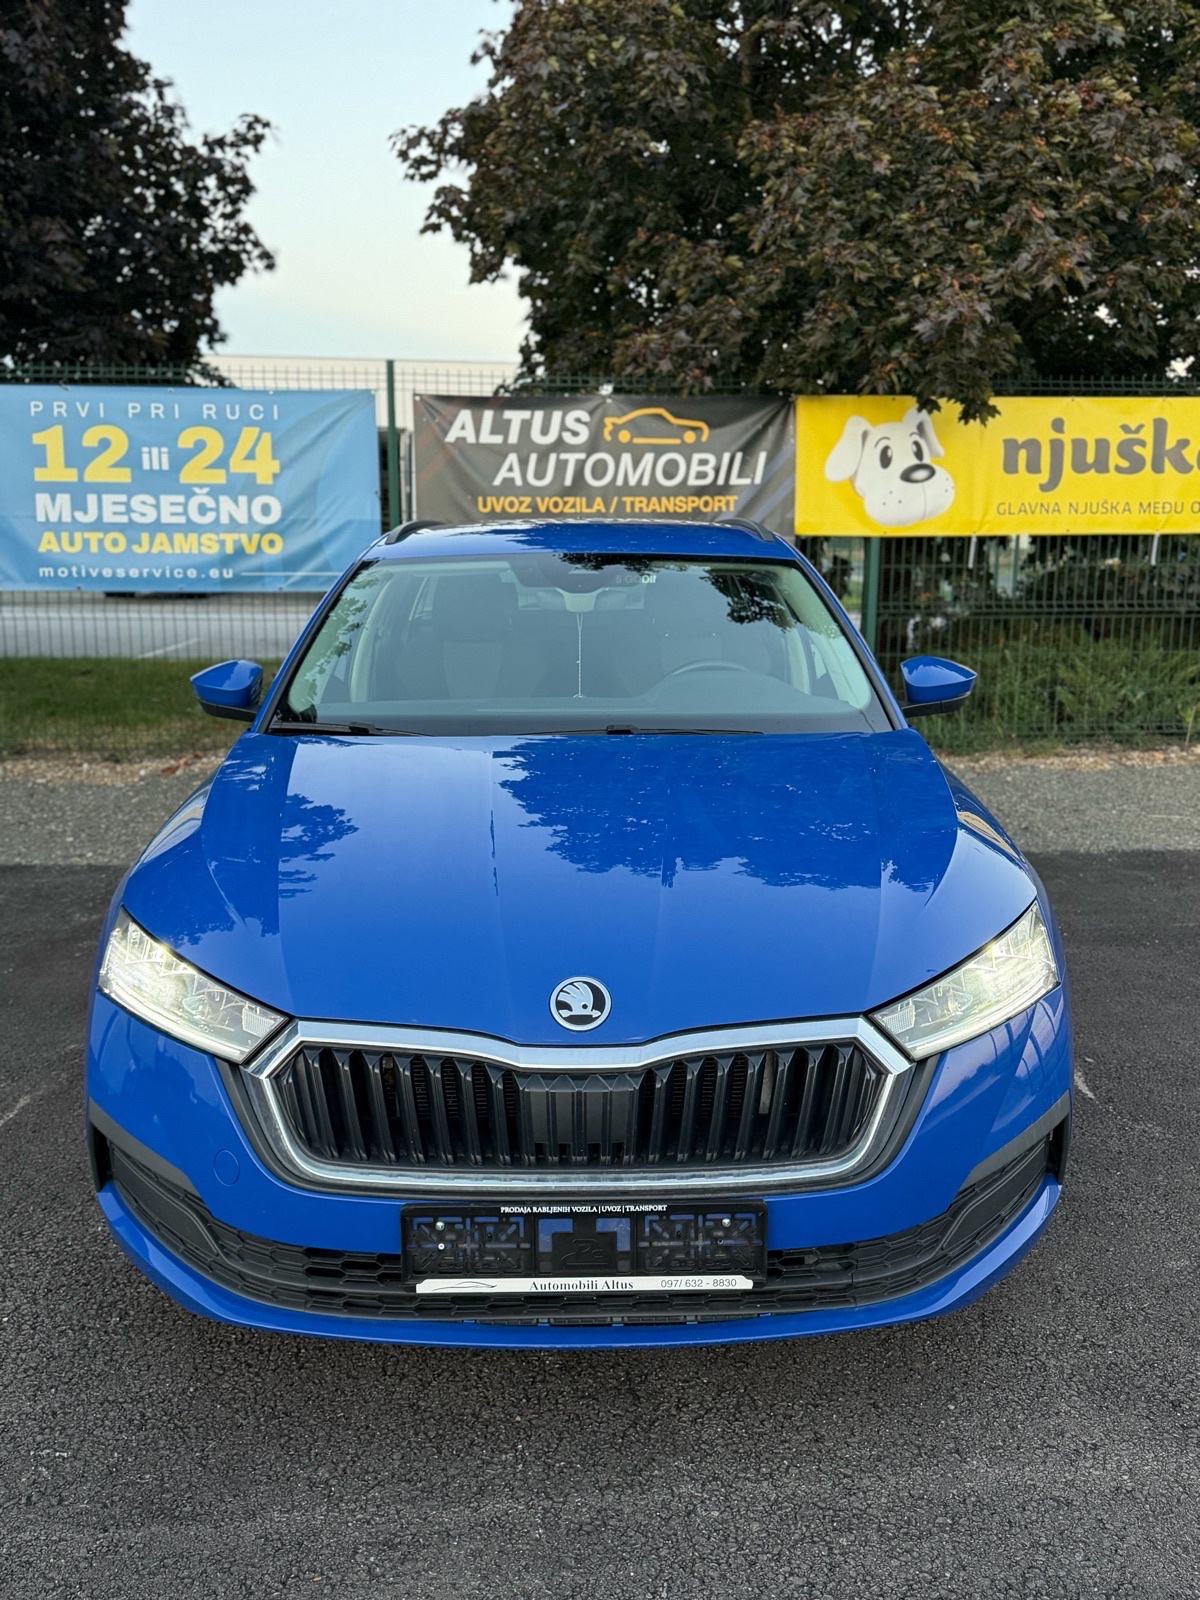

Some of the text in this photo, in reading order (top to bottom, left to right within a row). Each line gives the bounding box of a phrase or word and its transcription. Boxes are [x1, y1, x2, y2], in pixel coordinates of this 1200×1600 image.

[30, 401, 279, 420] PRVI PRI RUCI
[445, 409, 591, 444] ALTUS
[32, 425, 280, 485] 12 ili 24
[1001, 416, 1200, 492] njušk
[493, 451, 767, 487] AUTOMOBILI
[35, 487, 282, 525] MJESEČNO
[477, 496, 738, 513] UVOZ VOZILA / TRANSPORT
[996, 502, 1062, 516] GLAVNA
[1068, 499, 1132, 515] NJUŠKA
[38, 531, 284, 555] AUTO JAMSTVO
[38, 565, 234, 579] motiveservice.eu
[625, 1204, 668, 1212] TRANSPORT
[529, 1280, 598, 1291] Automobili
[601, 1280, 634, 1290] Altus
[660, 1279, 682, 1289] 097/
[684, 1279, 703, 1288] 632
[712, 1279, 737, 1288] 8830
